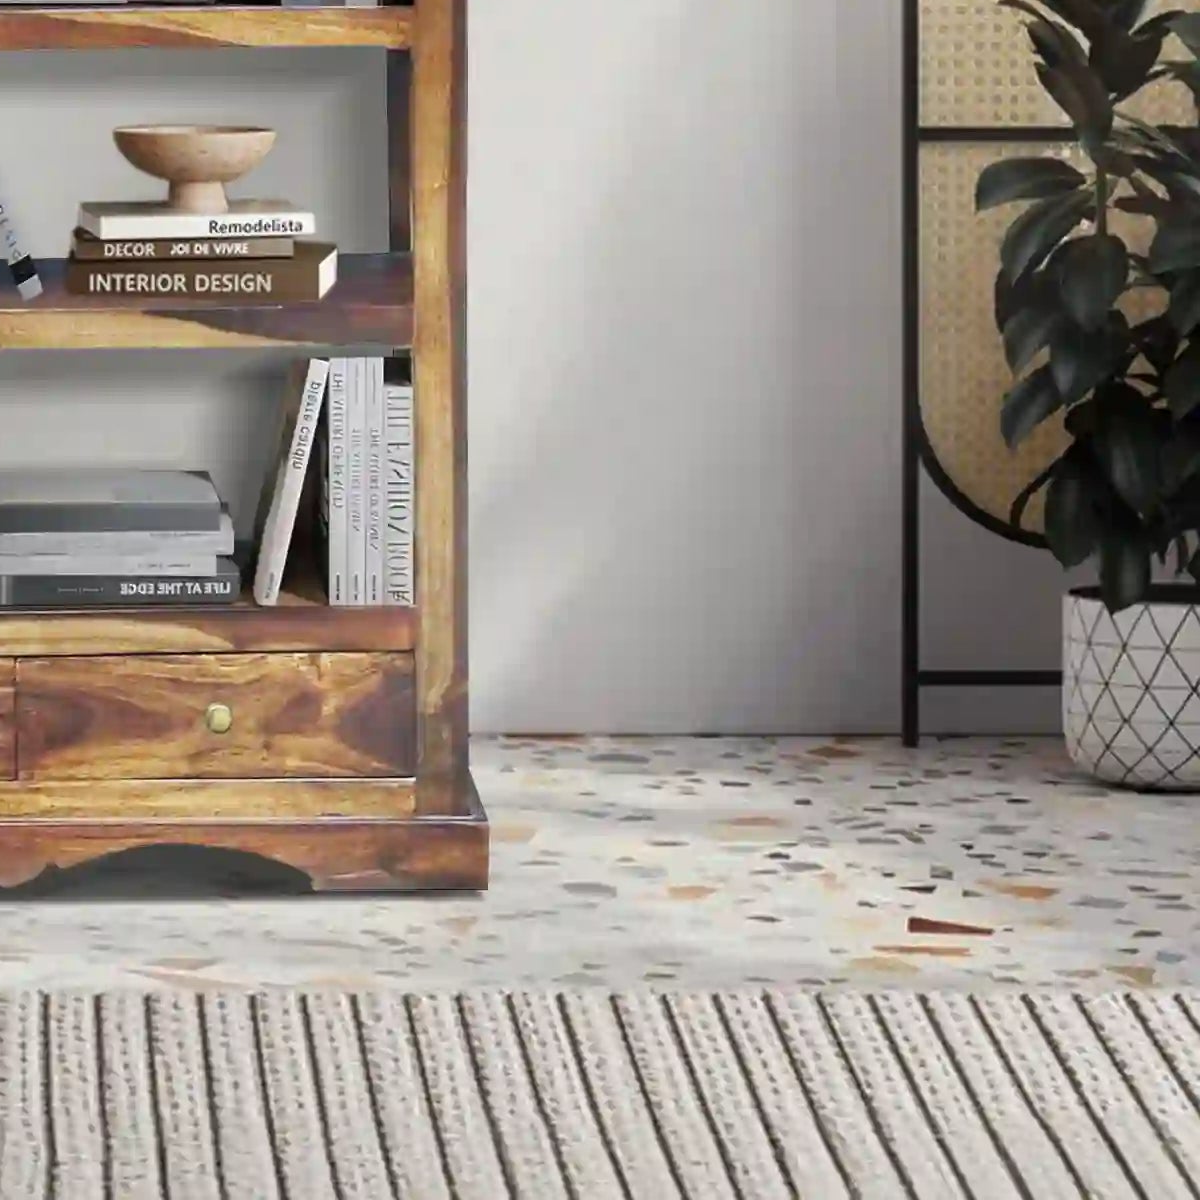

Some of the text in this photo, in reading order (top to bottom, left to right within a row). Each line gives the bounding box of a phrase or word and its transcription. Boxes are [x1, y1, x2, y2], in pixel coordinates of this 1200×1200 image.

[208, 220, 303, 235] Remodelista
[103, 243, 156, 257] DECOR
[89, 274, 273, 292] INTERIOR DESIGN
